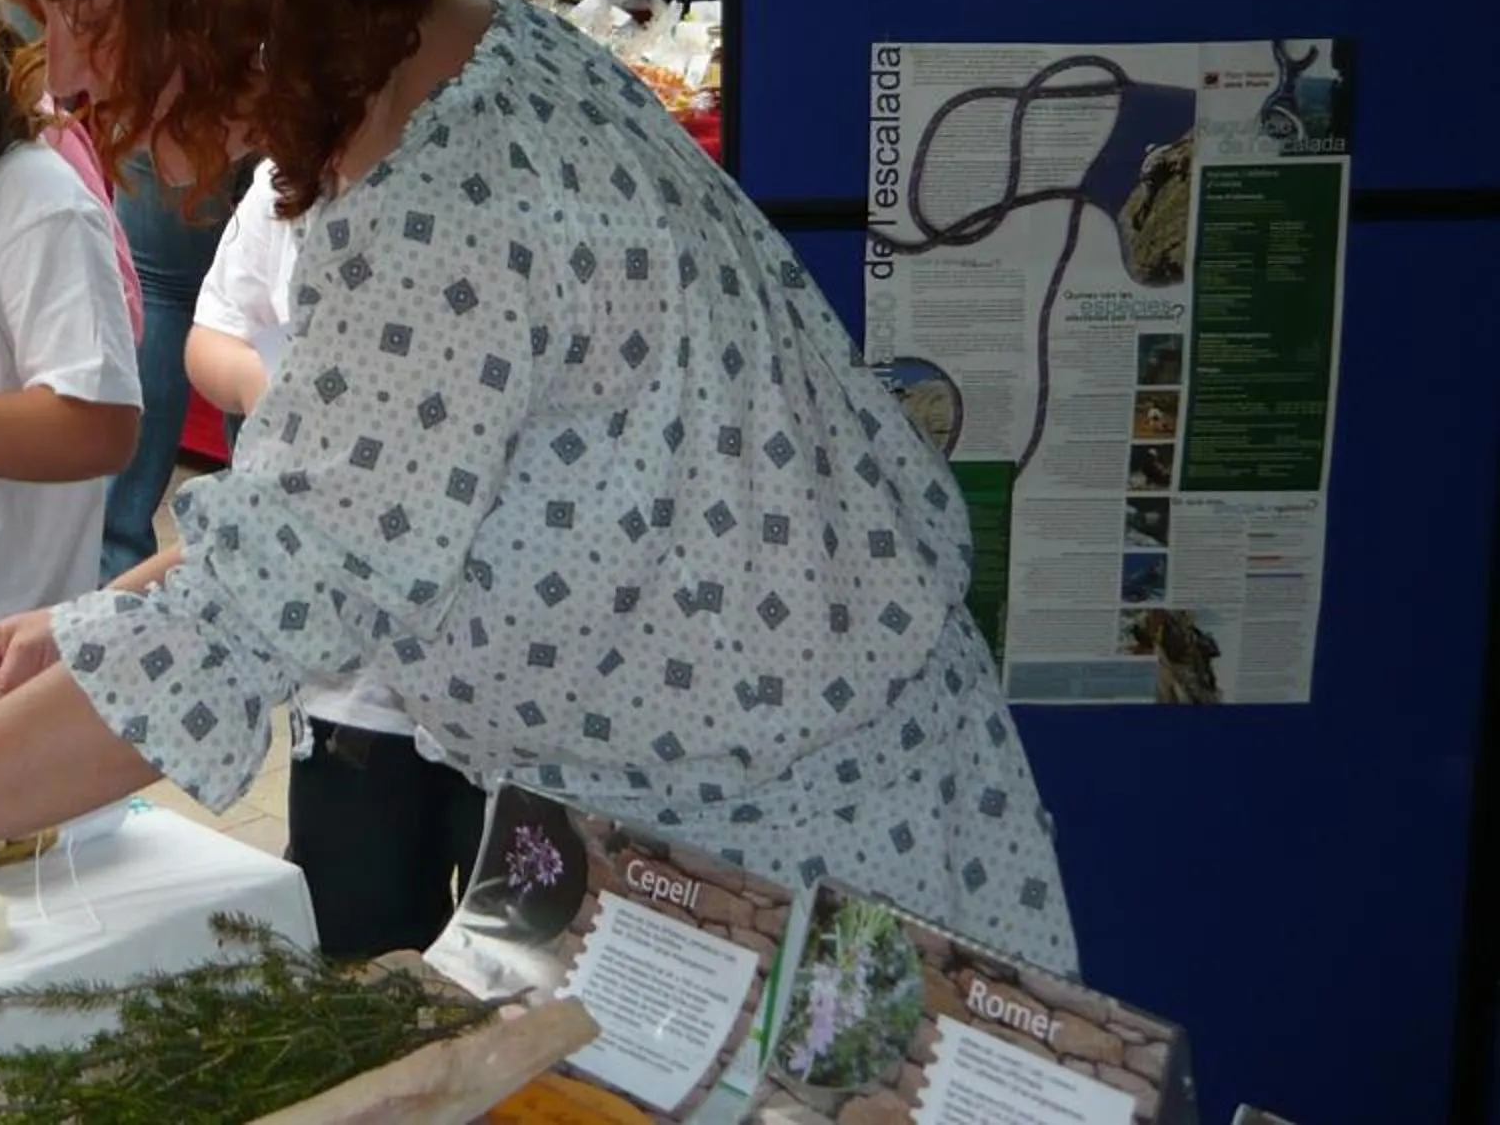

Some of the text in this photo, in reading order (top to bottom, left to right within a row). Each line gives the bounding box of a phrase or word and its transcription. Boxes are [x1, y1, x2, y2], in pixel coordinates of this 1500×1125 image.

[868, 46, 901, 227] l'escalada
[865, 239, 894, 280] de
[626, 859, 702, 909] Cepell
[966, 978, 1064, 1043] Romer
